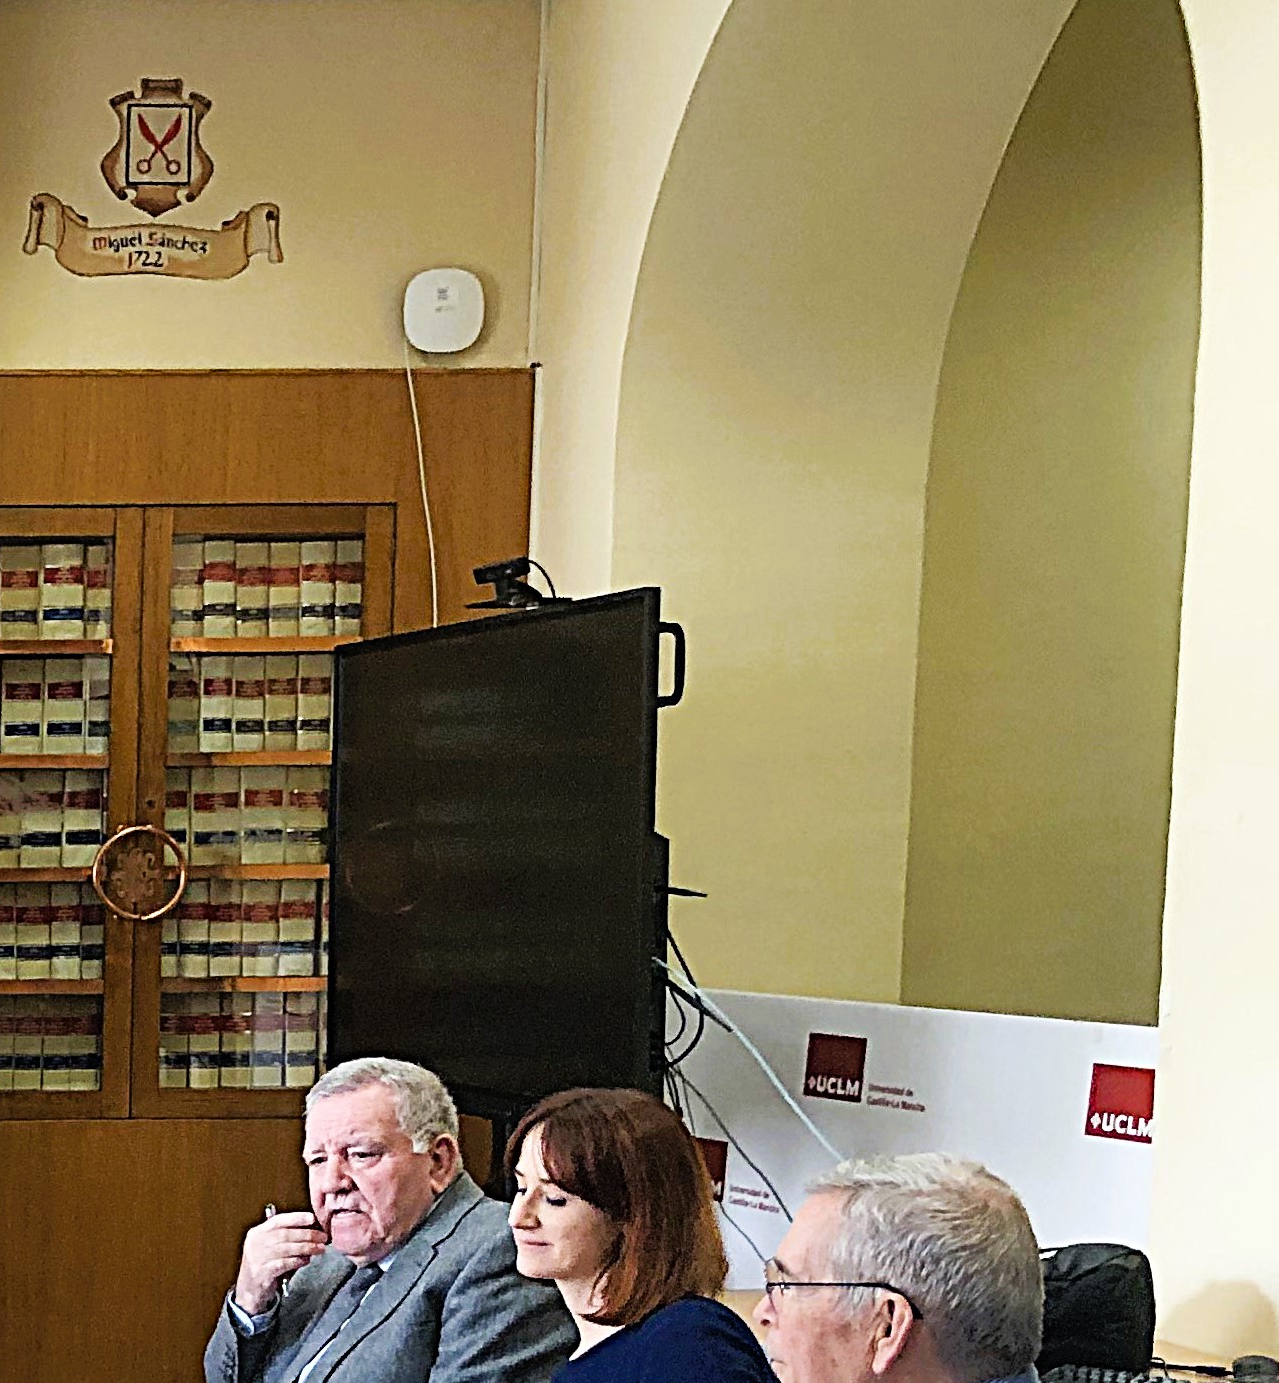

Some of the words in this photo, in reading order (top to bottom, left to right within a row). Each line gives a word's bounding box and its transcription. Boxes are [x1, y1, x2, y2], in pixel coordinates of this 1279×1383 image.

[127, 249, 164, 269] 1722
[815, 1074, 861, 1097] UCLM
[1101, 1111, 1154, 1138] UCLM
